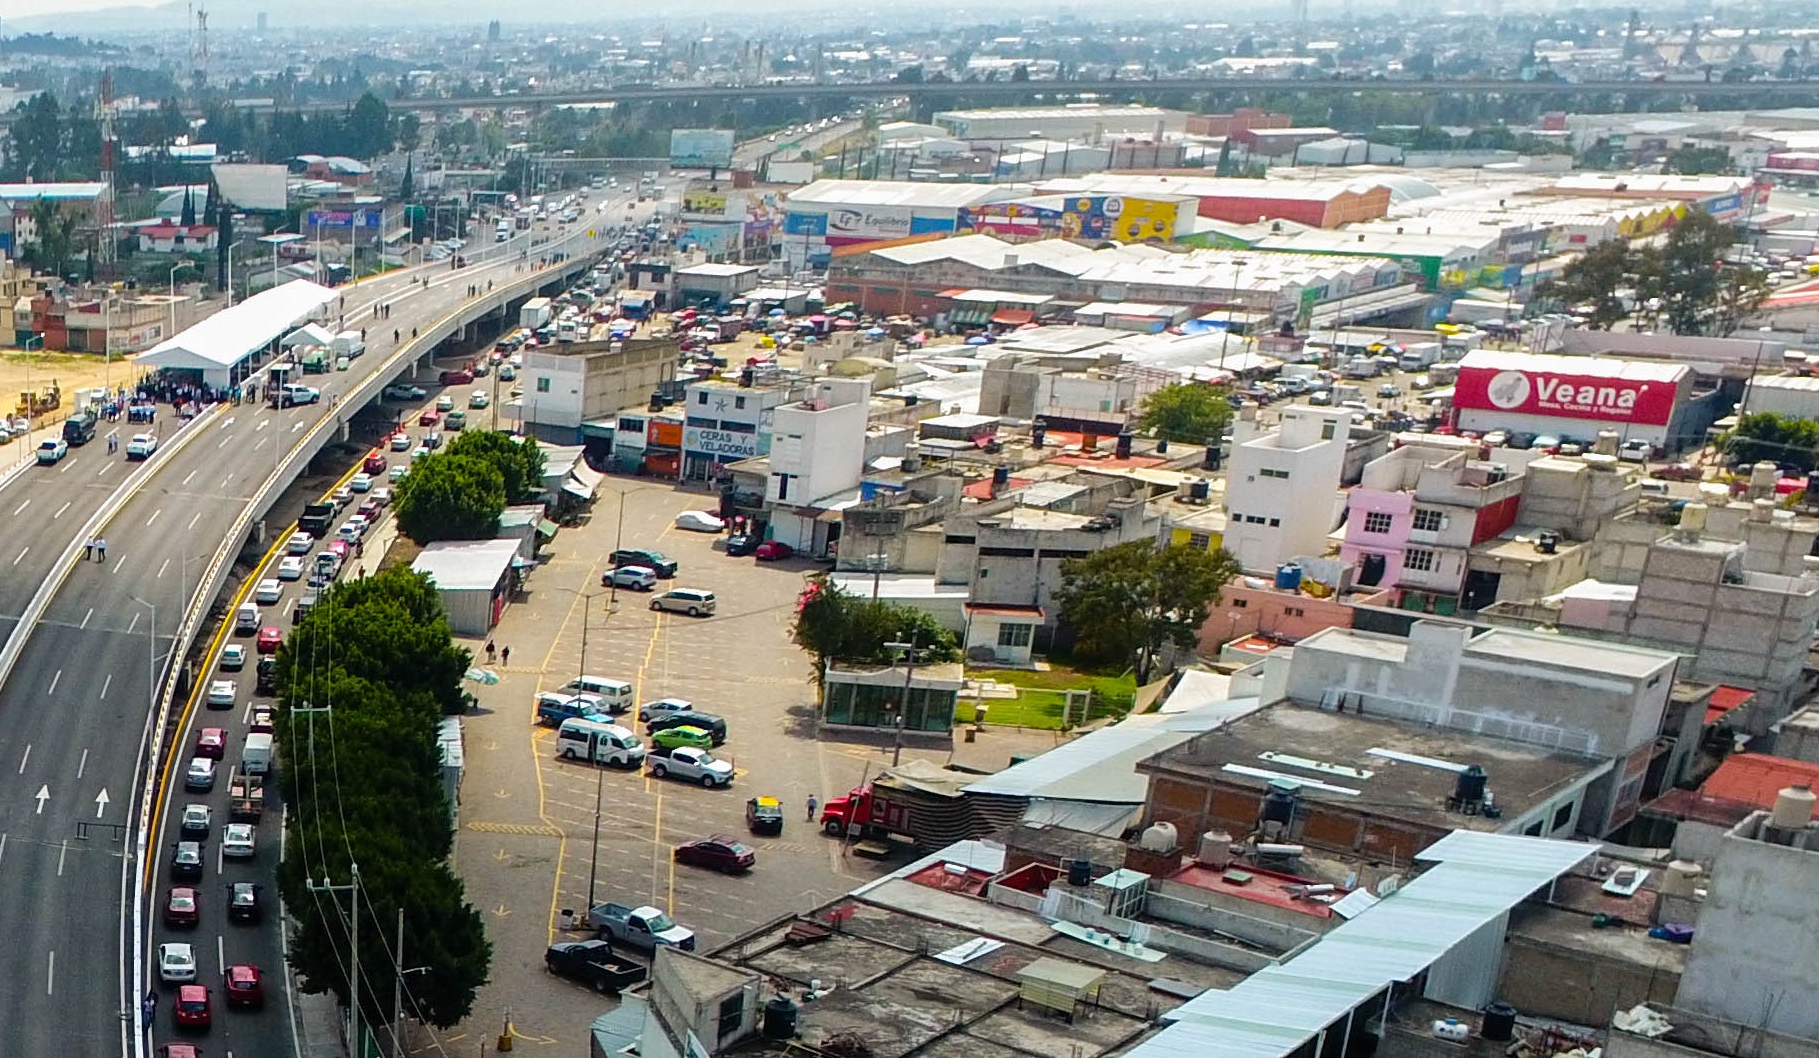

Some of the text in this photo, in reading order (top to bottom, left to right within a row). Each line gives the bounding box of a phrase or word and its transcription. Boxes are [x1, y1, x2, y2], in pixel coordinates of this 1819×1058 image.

[1536, 377, 1637, 408] Veana
[700, 430, 748, 444] CERAS Y
[700, 441, 754, 456] VELADORAS
